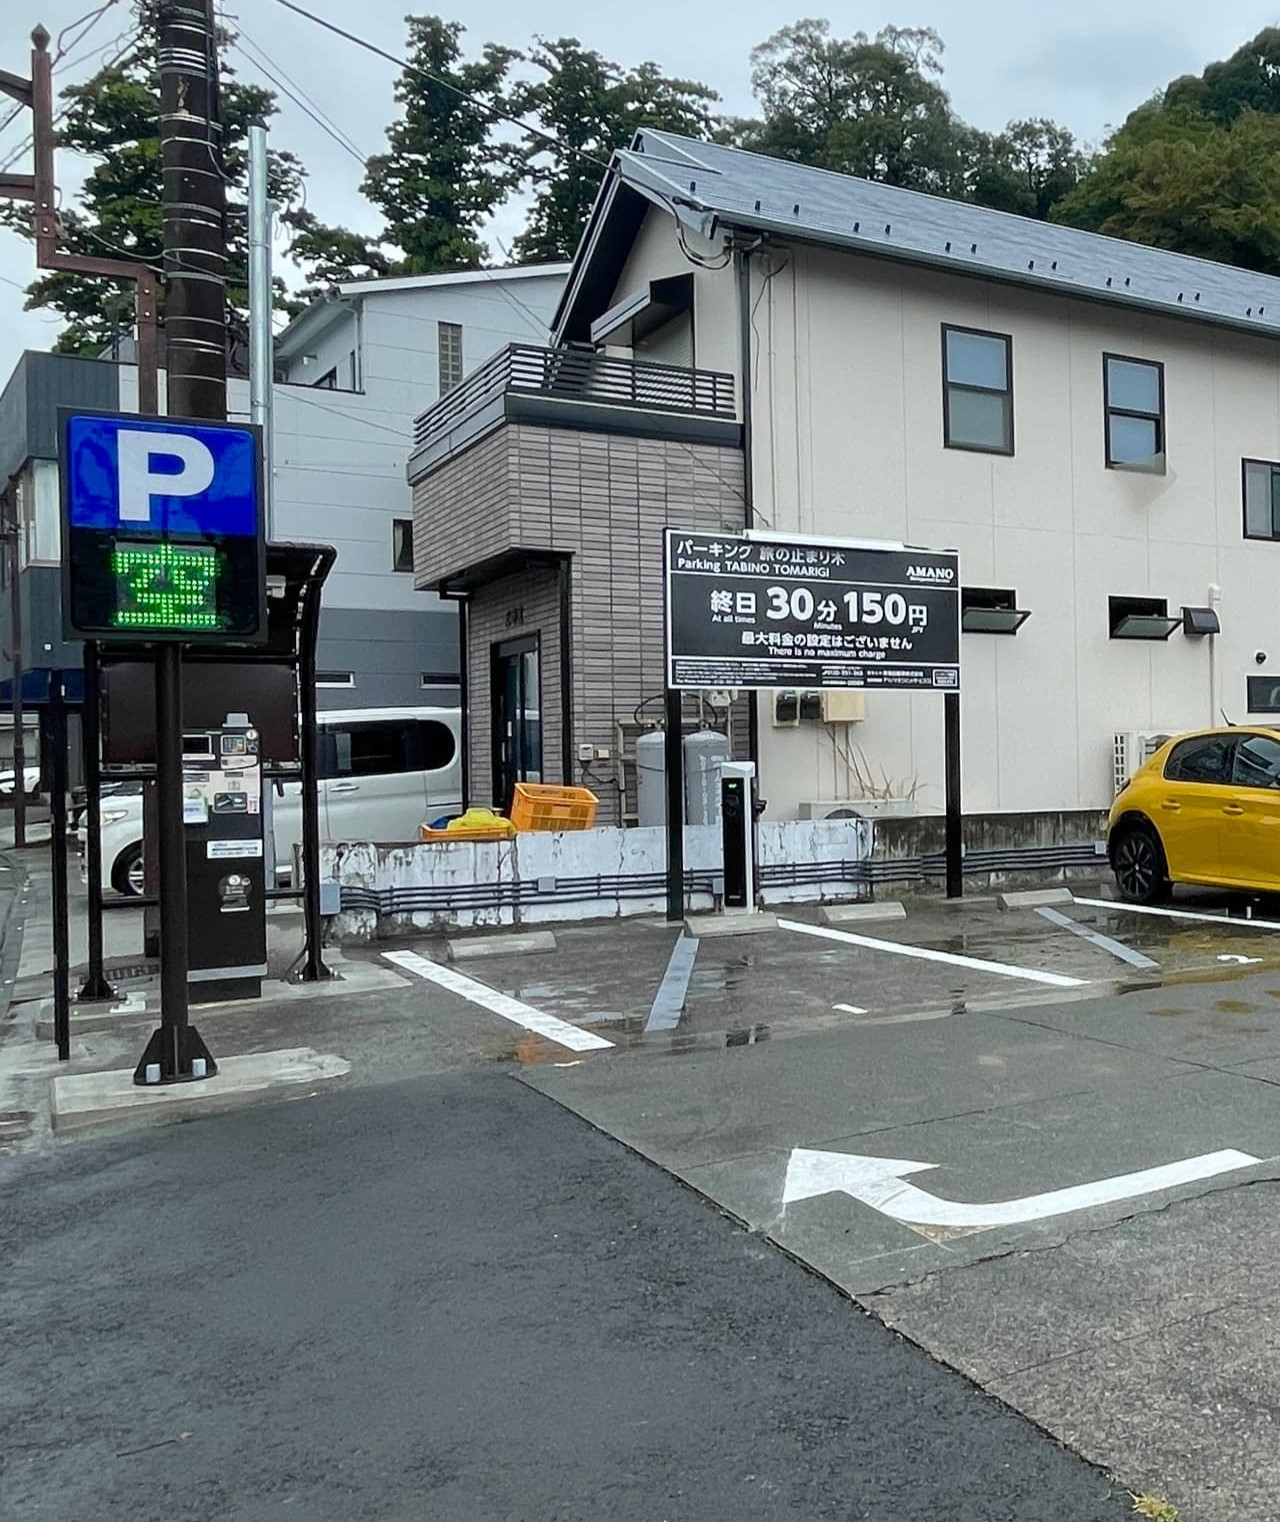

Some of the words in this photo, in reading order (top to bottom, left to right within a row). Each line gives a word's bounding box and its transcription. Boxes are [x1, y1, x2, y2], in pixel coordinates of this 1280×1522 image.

[117, 429, 215, 521] P
[677, 539, 753, 559] パーキング
[760, 546, 846, 566] 旅の止まり木
[678, 558, 721, 572] Parking
[725, 561, 769, 574] TABINO
[773, 564, 830, 577] TOMARIGI
[906, 566, 954, 579] AMANO
[113, 544, 218, 626] 空
[710, 589, 756, 613] 終日
[735, 615, 756, 624] times
[813, 622, 843, 631] Minutes
[742, 631, 912, 650] 最大料金の設定はございません
[768, 646, 793, 656] There
[794, 648, 802, 656] is
[804, 648, 816, 656] no
[817, 649, 857, 658] maximum
[858, 650, 886, 660] charge
